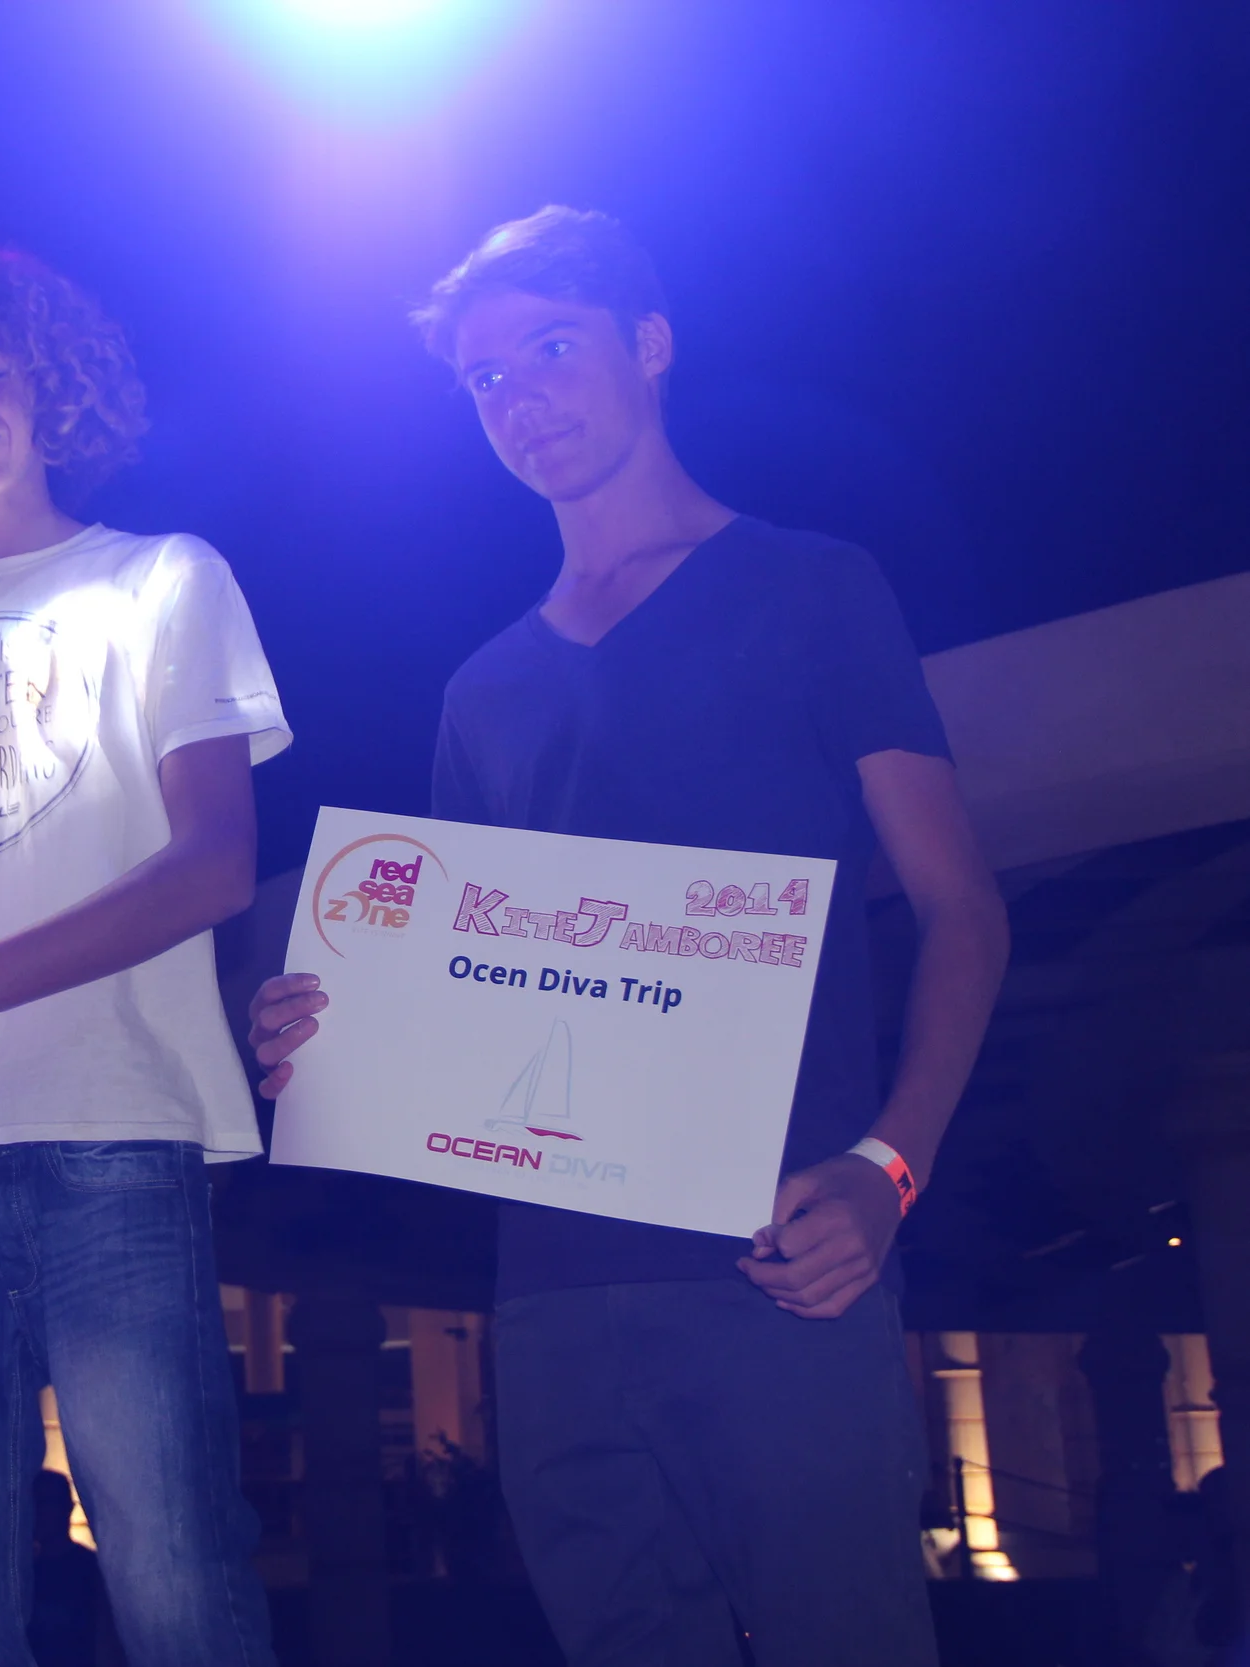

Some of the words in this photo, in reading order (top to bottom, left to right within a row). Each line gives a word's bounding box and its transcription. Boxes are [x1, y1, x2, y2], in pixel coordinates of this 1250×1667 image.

[368, 855, 424, 884] red
[358, 880, 415, 907] sea
[685, 878, 809, 917] 2014
[448, 955, 528, 988] Ocen
[537, 966, 608, 999] Diva
[619, 976, 683, 1014] Trip
[425, 1131, 543, 1171] OCEAN
[547, 1153, 628, 1187] DIVA
